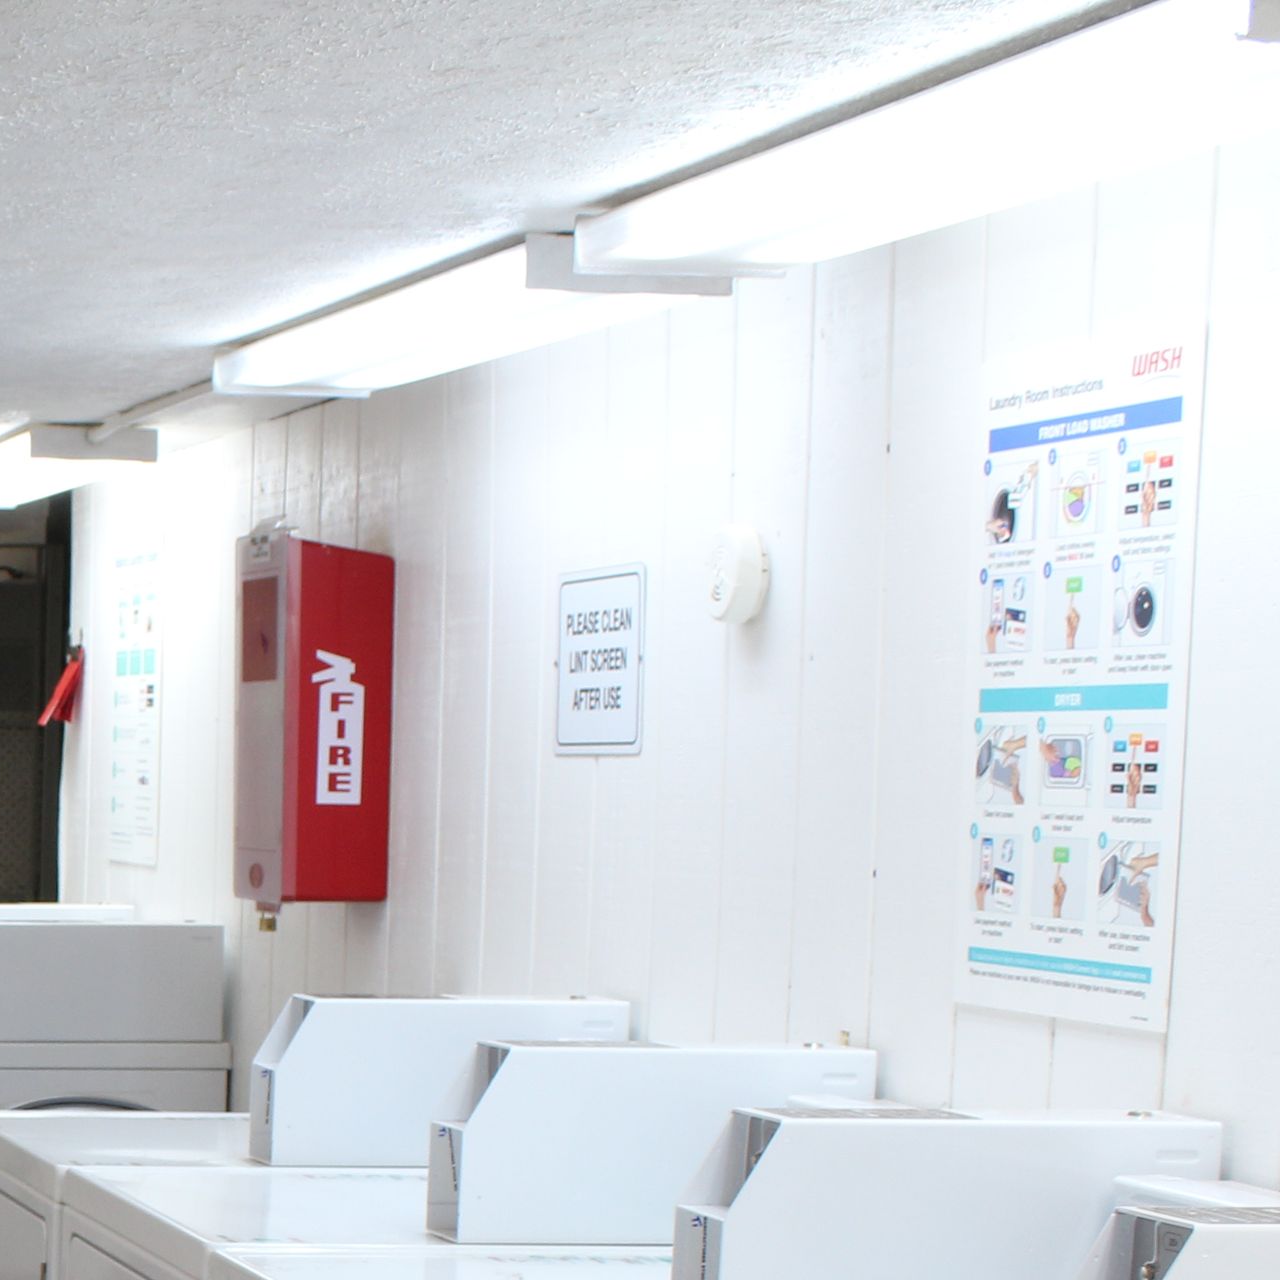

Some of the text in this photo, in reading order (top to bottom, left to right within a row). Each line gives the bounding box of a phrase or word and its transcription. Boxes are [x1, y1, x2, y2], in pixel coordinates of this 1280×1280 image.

[1131, 346, 1183, 377] WASH
[989, 378, 1103, 411] Laundry Room Instructions
[1039, 413, 1125, 440] FRONT LOAD WASHER
[566, 607, 632, 637] PLEASE CLEAN
[569, 647, 627, 673] LINT SCREEN
[572, 686, 622, 711] AFTER USE
[1054, 693, 1082, 707] DRYER
[328, 692, 354, 793] FIRE
